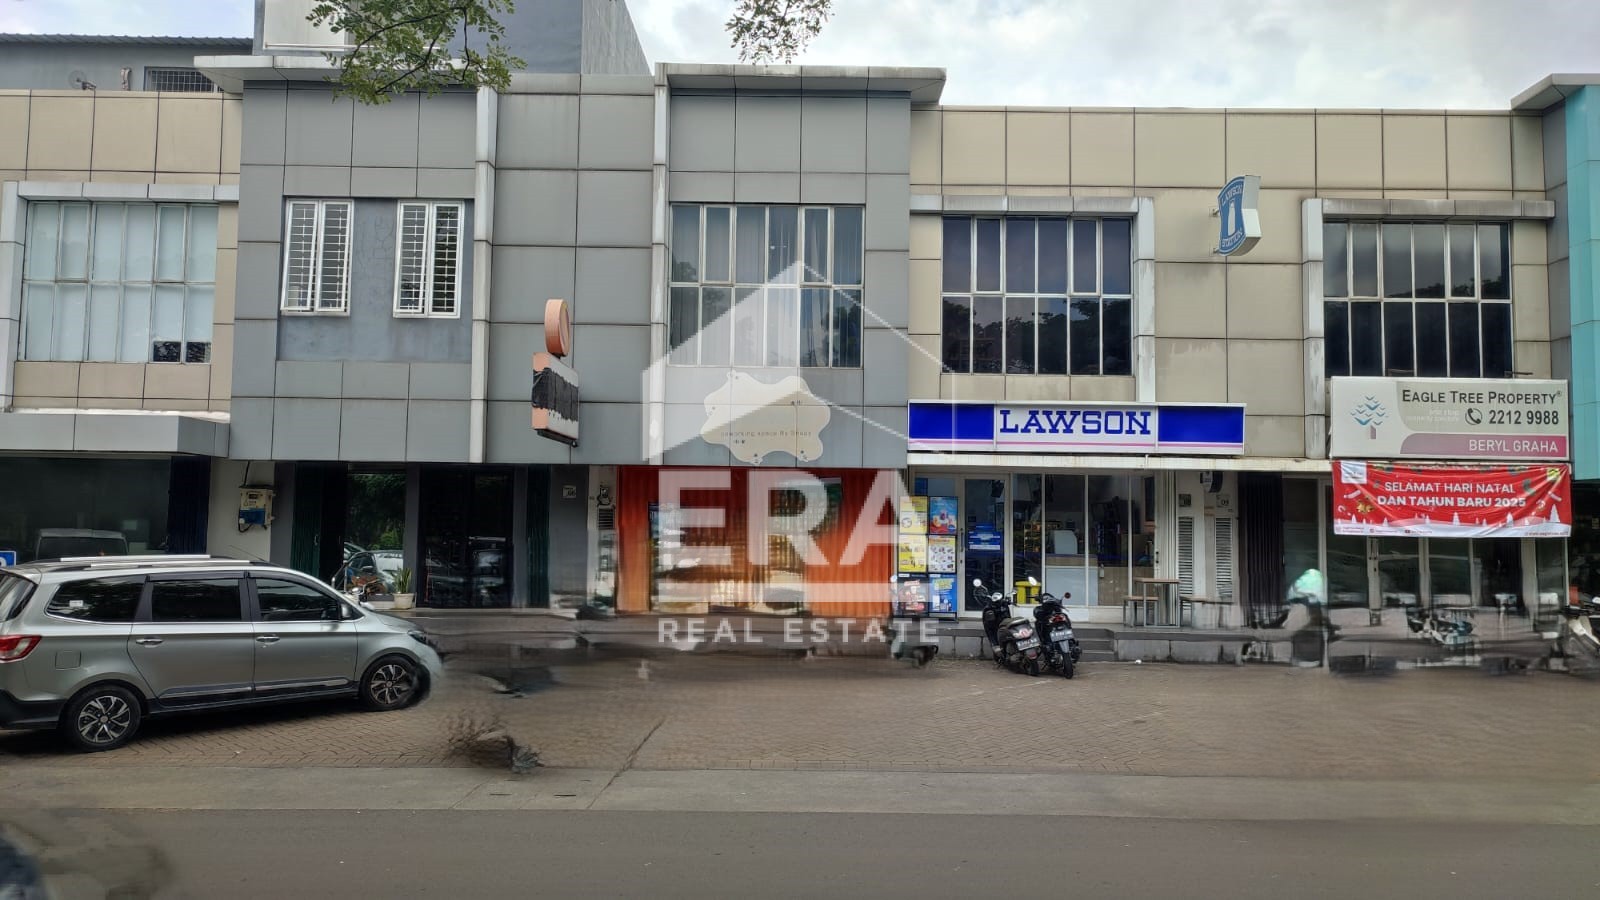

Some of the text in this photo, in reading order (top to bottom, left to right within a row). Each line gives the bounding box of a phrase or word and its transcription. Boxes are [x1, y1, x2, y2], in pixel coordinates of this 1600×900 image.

[1402, 389, 1446, 404] EAGLE
[1450, 391, 1484, 404] TREE
[1000, 409, 1151, 435] LAWSON
[1489, 409, 1560, 425] 2212 9988
[1469, 439, 1559, 453] BERYL GRAHA
[1384, 481, 1515, 494] SELAMAT HARI NATAL
[1377, 495, 1526, 508] DAN TAHUN BARU 2025
